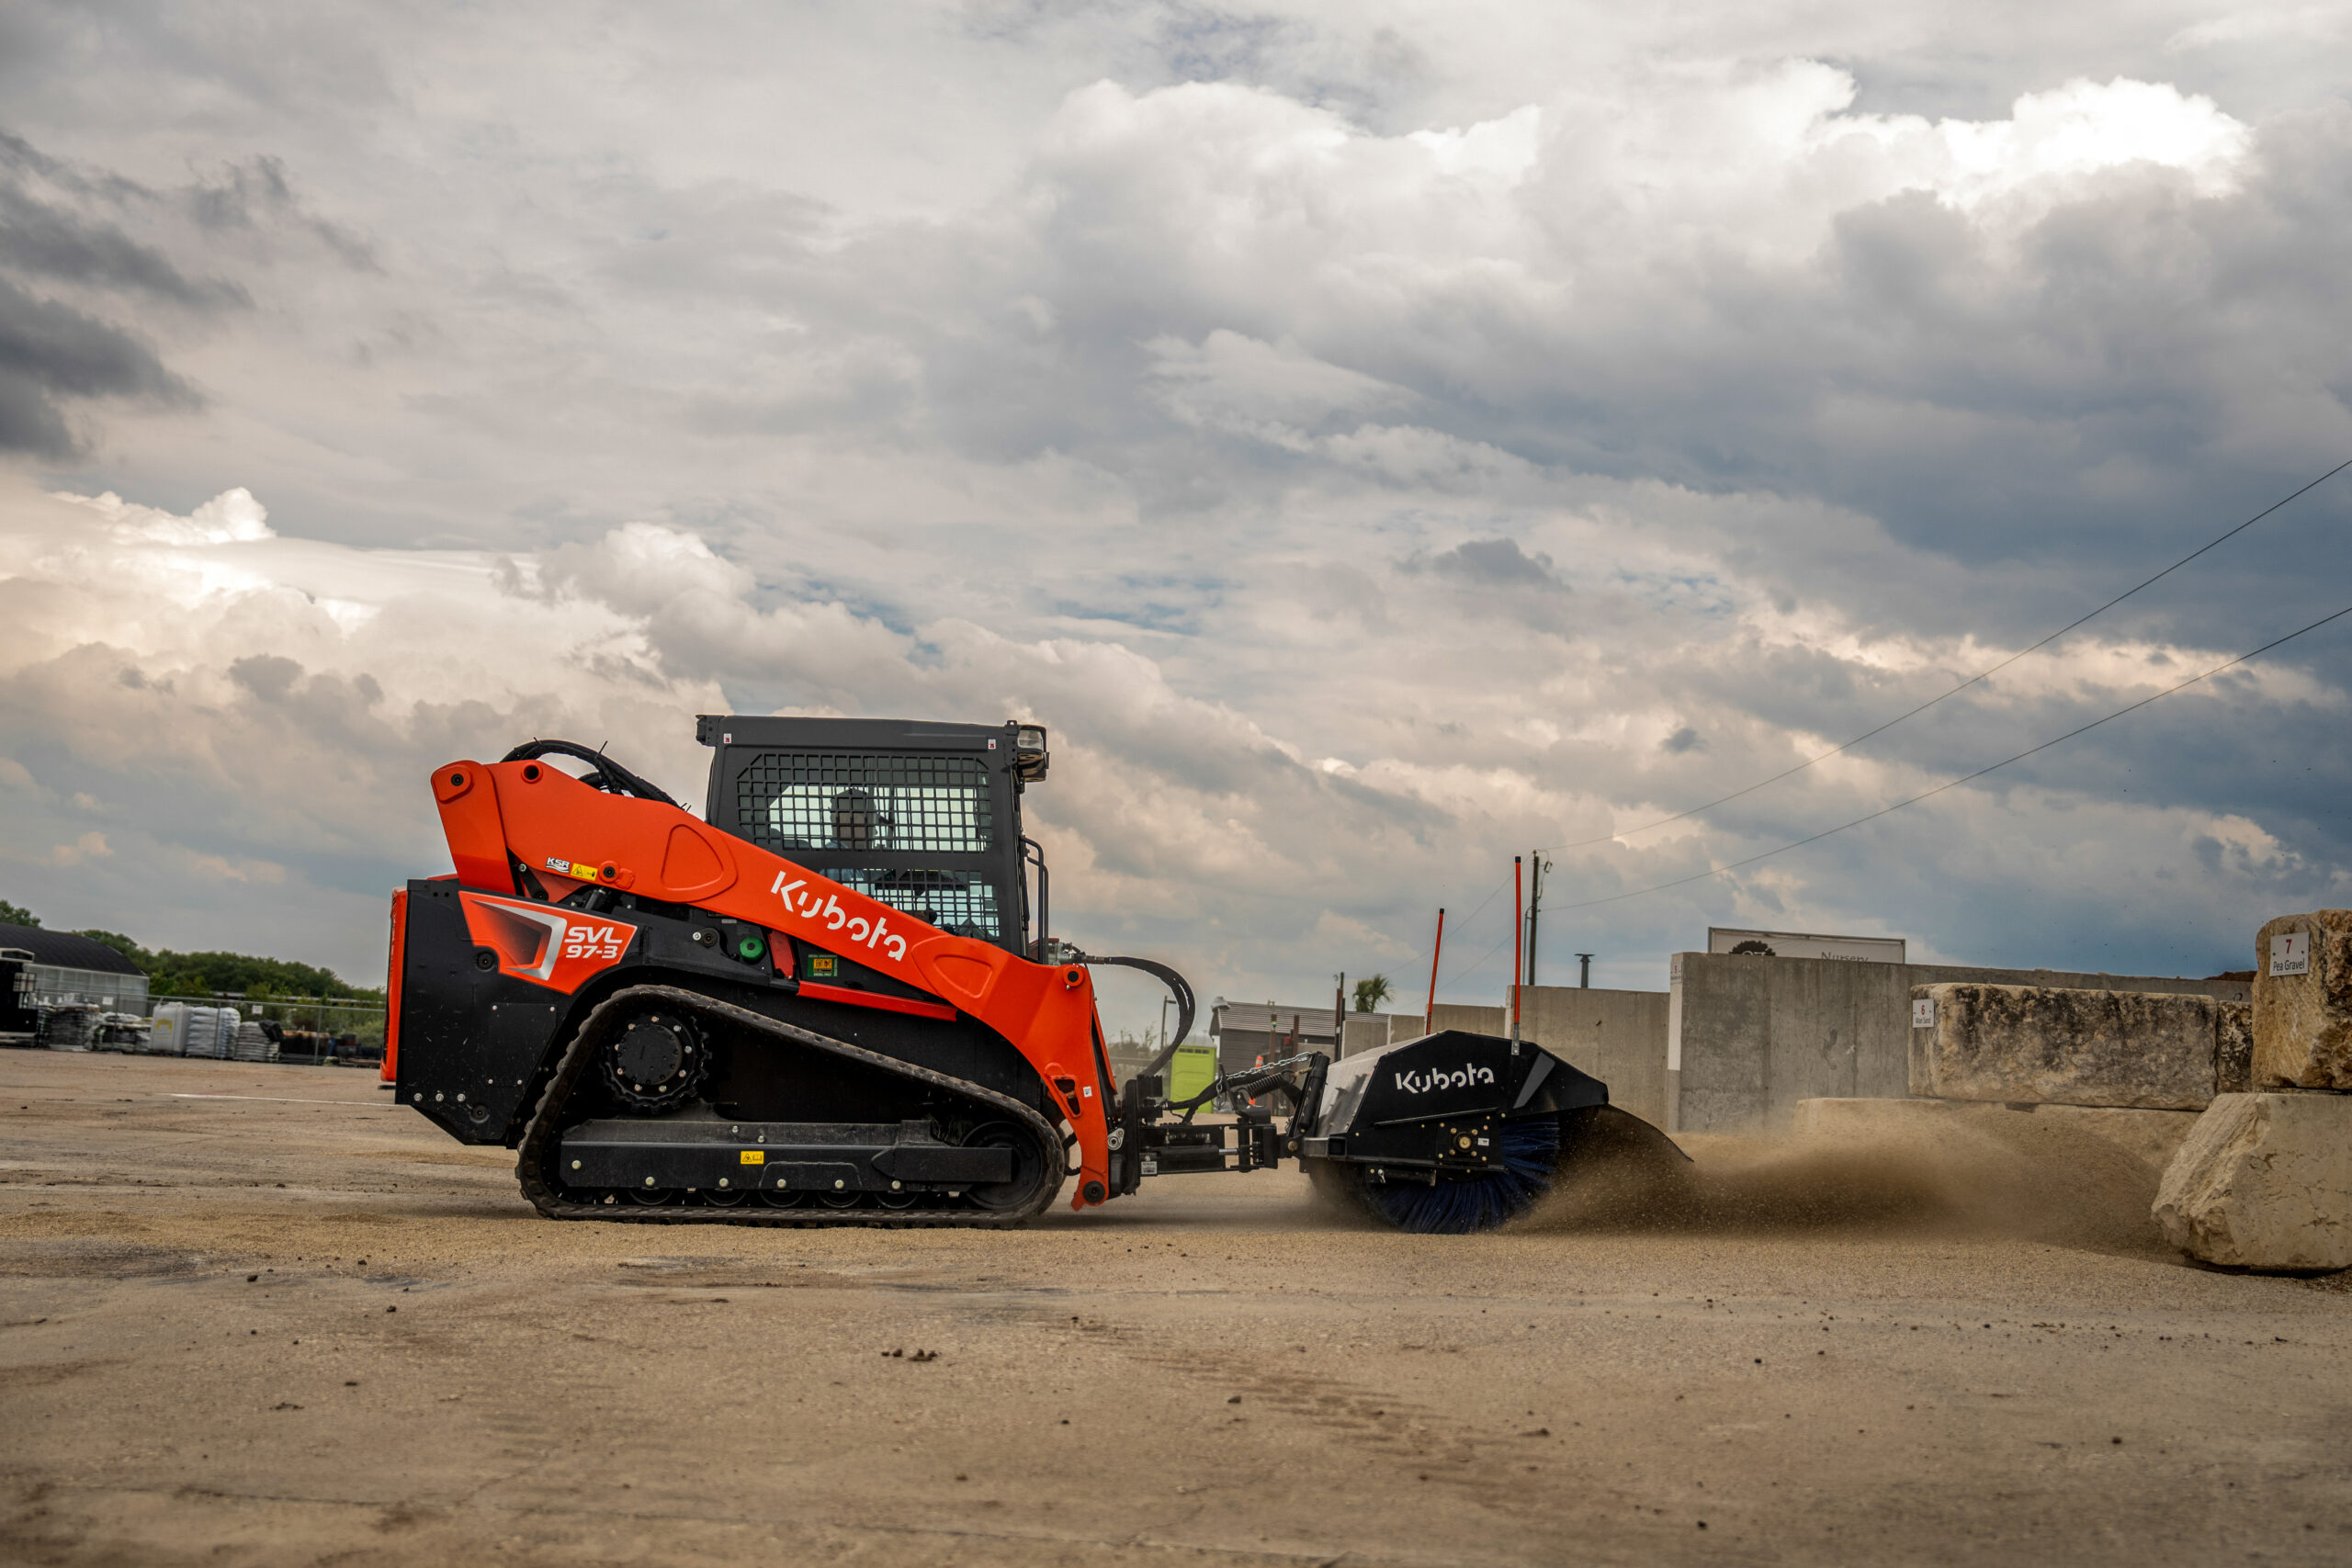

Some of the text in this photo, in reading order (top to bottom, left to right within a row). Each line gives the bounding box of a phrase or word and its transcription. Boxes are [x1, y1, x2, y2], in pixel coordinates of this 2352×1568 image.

[546, 857, 570, 868] KSR
[770, 870, 907, 962] Kubota
[564, 926, 623, 943] SVL
[565, 944, 618, 959] 97-3
[2285, 938, 2292, 954] 7
[2273, 957, 2305, 972] Pea Gravel
[1921, 1004, 1926, 1016] 6
[1395, 1063, 1495, 1094] Kubota
